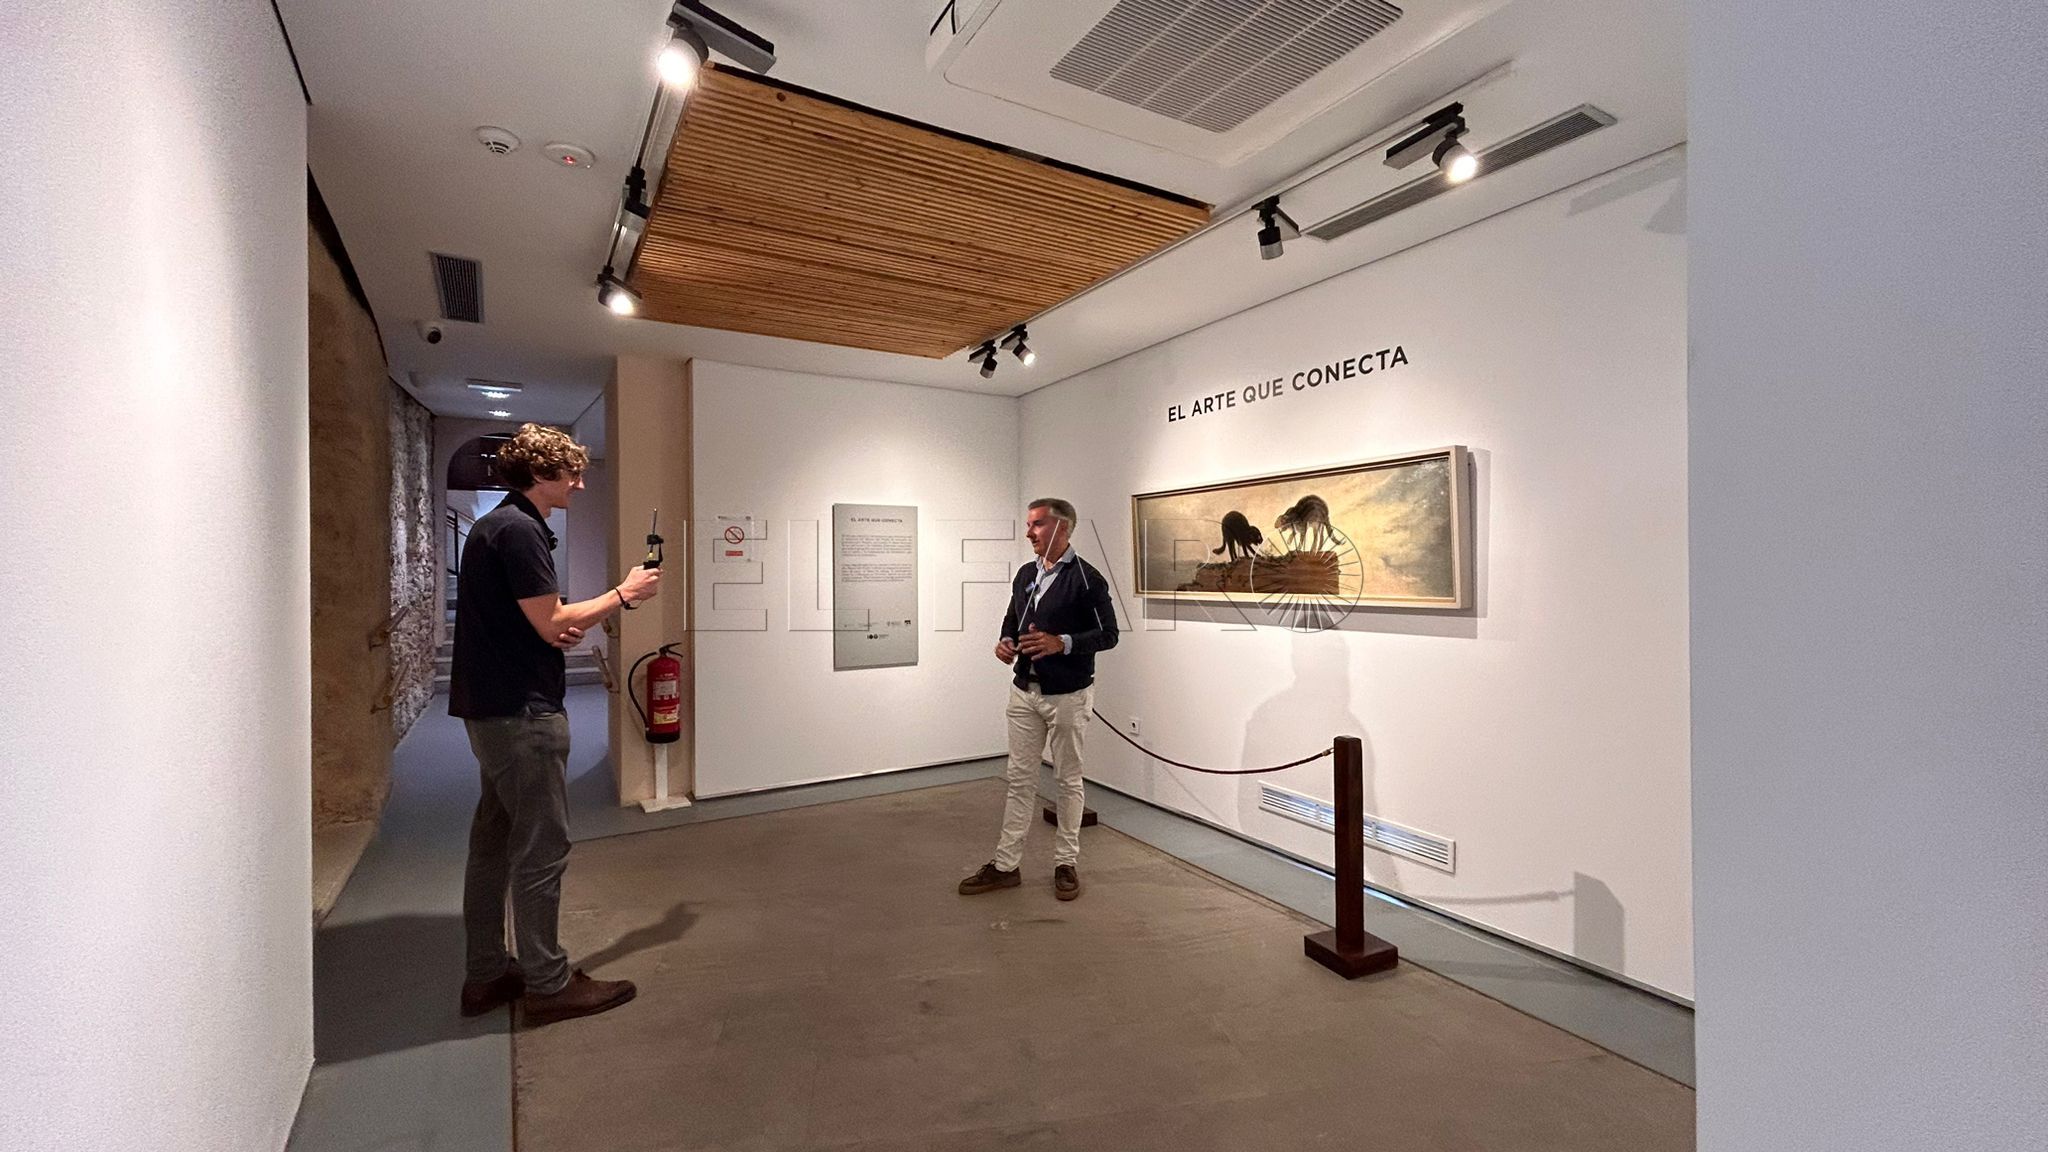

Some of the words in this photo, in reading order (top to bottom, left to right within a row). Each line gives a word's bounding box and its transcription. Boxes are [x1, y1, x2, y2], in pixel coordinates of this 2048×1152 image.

[1168, 405, 1186, 423] EL
[1191, 390, 1236, 417] ARTE
[1242, 377, 1284, 404] QUE
[1291, 345, 1409, 392] CONECTA
